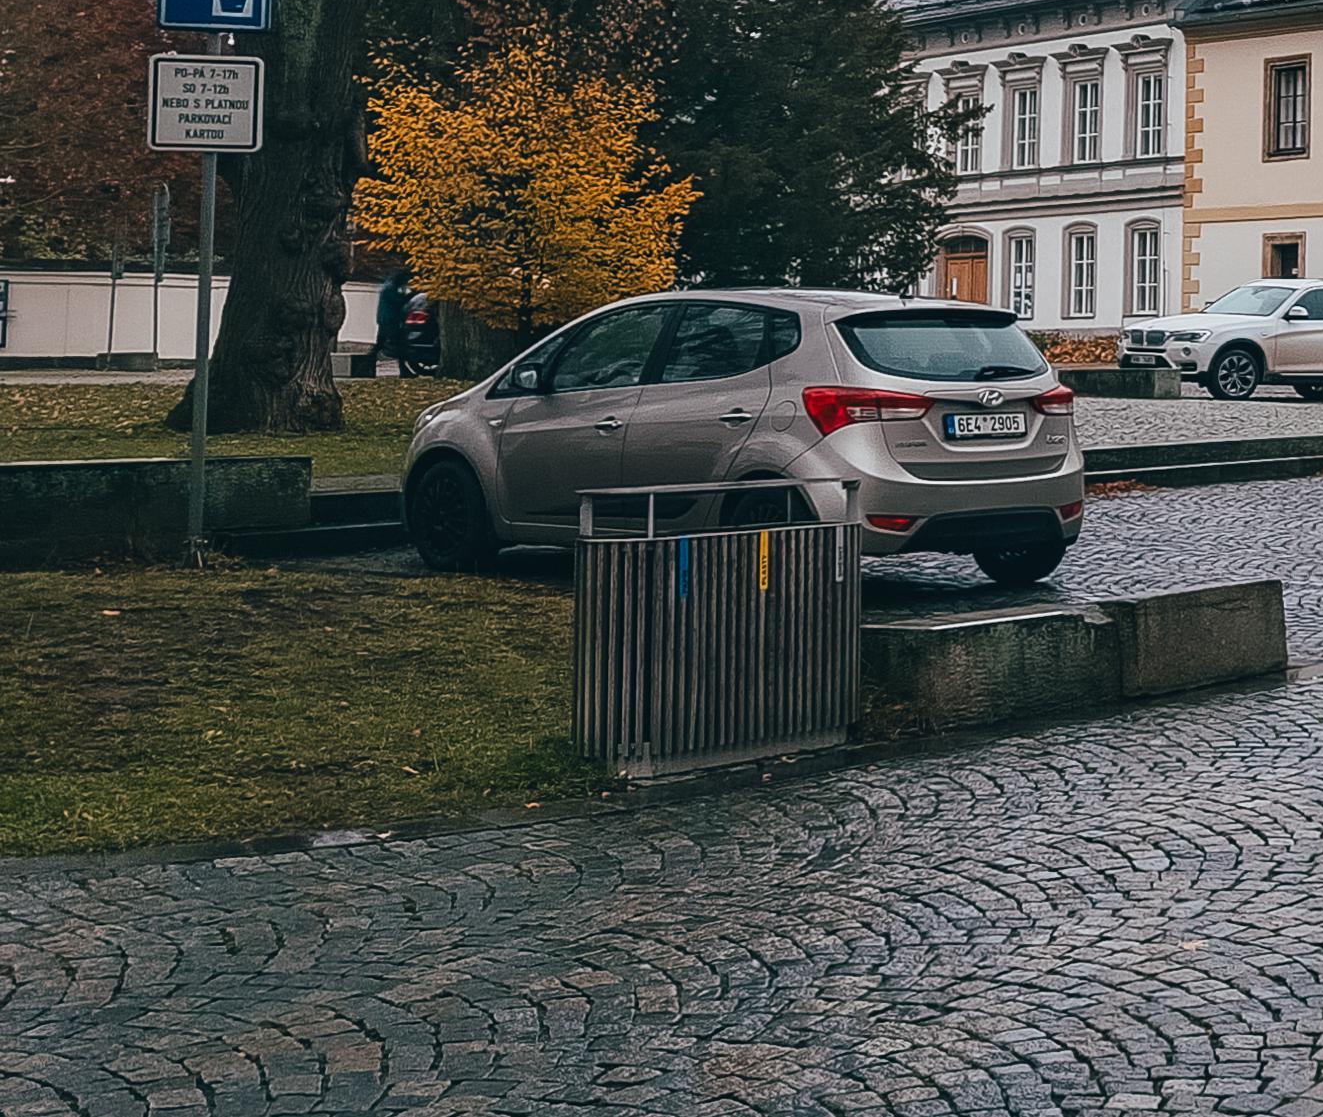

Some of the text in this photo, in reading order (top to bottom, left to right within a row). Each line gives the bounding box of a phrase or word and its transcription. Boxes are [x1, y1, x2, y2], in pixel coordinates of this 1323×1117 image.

[174, 66, 239, 79] PO-PÁ 7-17h
[182, 83, 229, 94] SO 7-12h
[162, 97, 249, 110] NEBO S PLATNOU
[178, 112, 232, 124] PARKOVACÍ
[185, 129, 224, 139] KARTOU
[957, 415, 1020, 433] 6E4 2905
